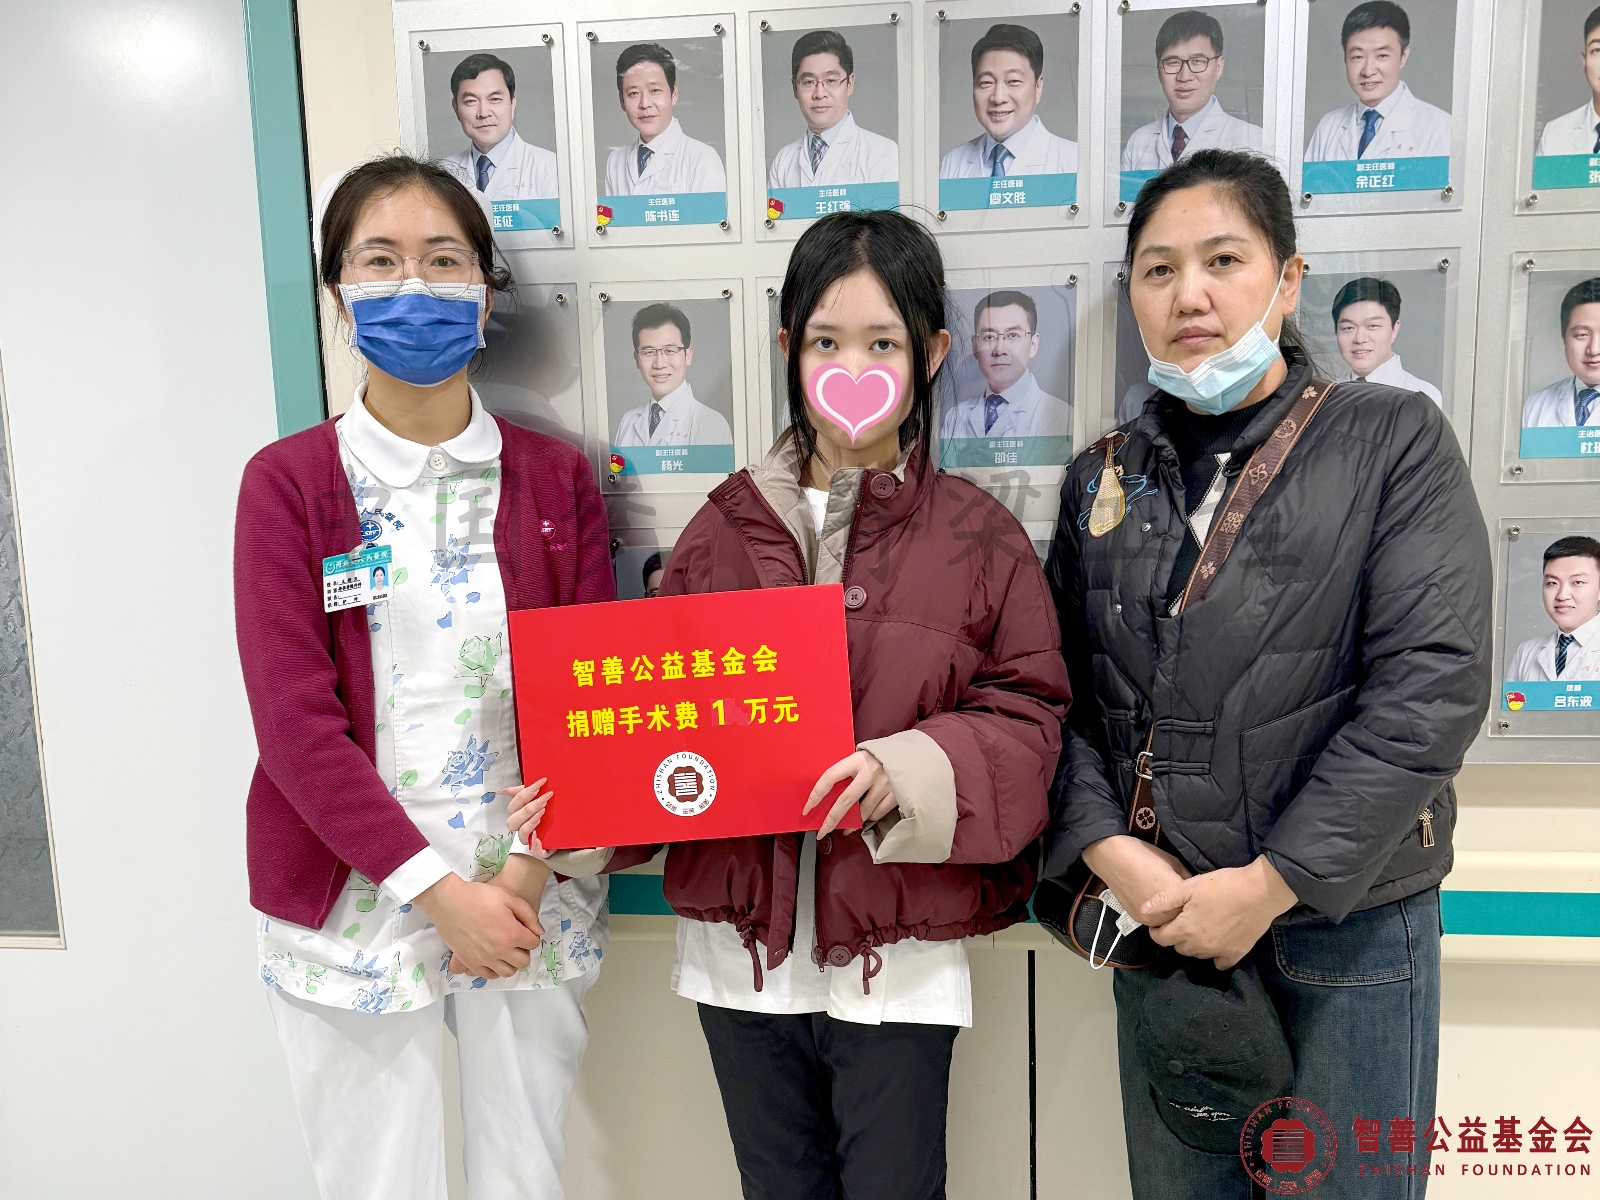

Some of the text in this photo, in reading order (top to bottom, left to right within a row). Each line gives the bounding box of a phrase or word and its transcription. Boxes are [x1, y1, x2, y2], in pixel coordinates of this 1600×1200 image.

[1356, 162, 1395, 172] 副主任医师
[993, 179, 1024, 189] 主任医师
[1356, 174, 1395, 189] 余正红
[818, 188, 847, 198] 主任医师
[990, 192, 1026, 205] 廖文胜
[648, 197, 676, 206] 主任医师
[815, 200, 851, 214] 王红强
[645, 209, 680, 223] 陈书连
[989, 440, 1024, 449] 副主任医师
[655, 448, 689, 457] 副主任医师
[994, 451, 1018, 464] 邵佳
[661, 459, 684, 472] 杨光
[571, 645, 779, 688] 智善公益基金会
[1554, 695, 1593, 708] 吕东波
[655, 758, 673, 795] ZHISHAN
